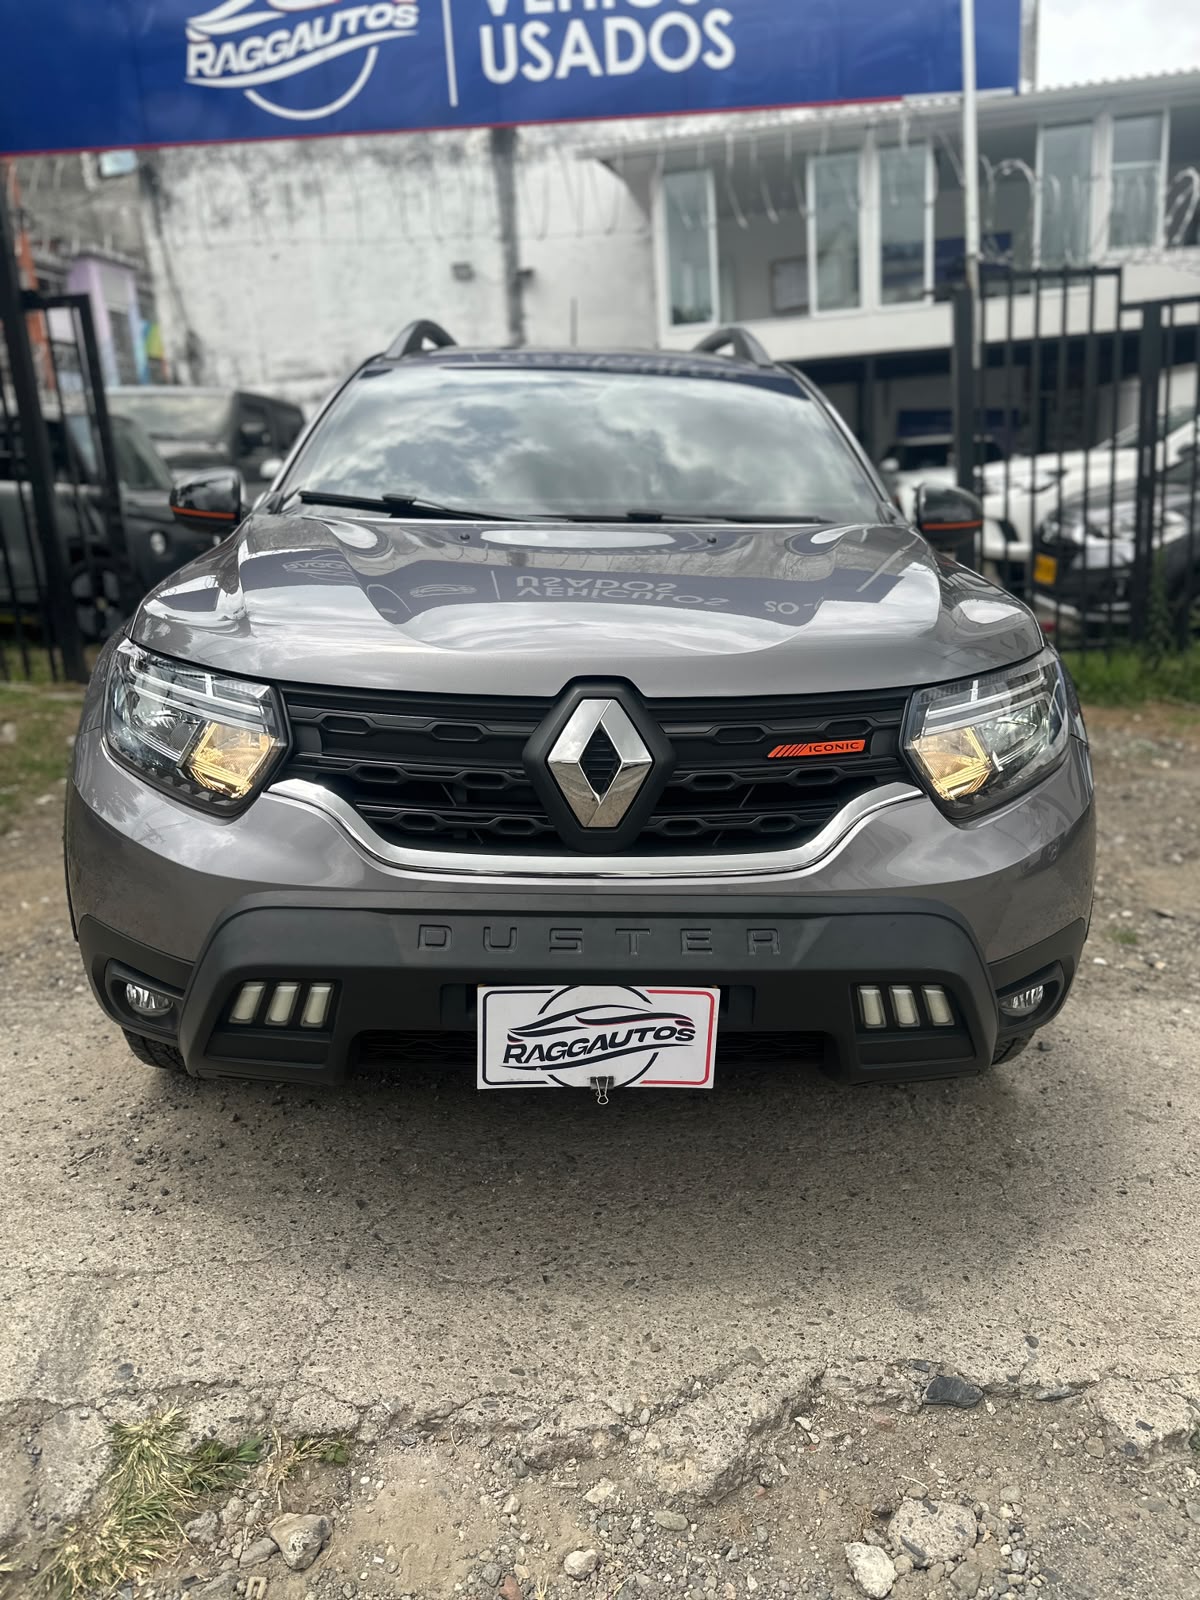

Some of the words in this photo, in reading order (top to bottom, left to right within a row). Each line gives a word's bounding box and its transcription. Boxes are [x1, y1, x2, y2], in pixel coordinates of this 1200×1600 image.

[186, 4, 419, 78] RAGGAUTOS
[479, 8, 736, 84] USADOS
[809, 742, 859, 752] ICONIC
[417, 924, 781, 956] DUSTER
[503, 1026, 696, 1064] RAGGAUTOS
